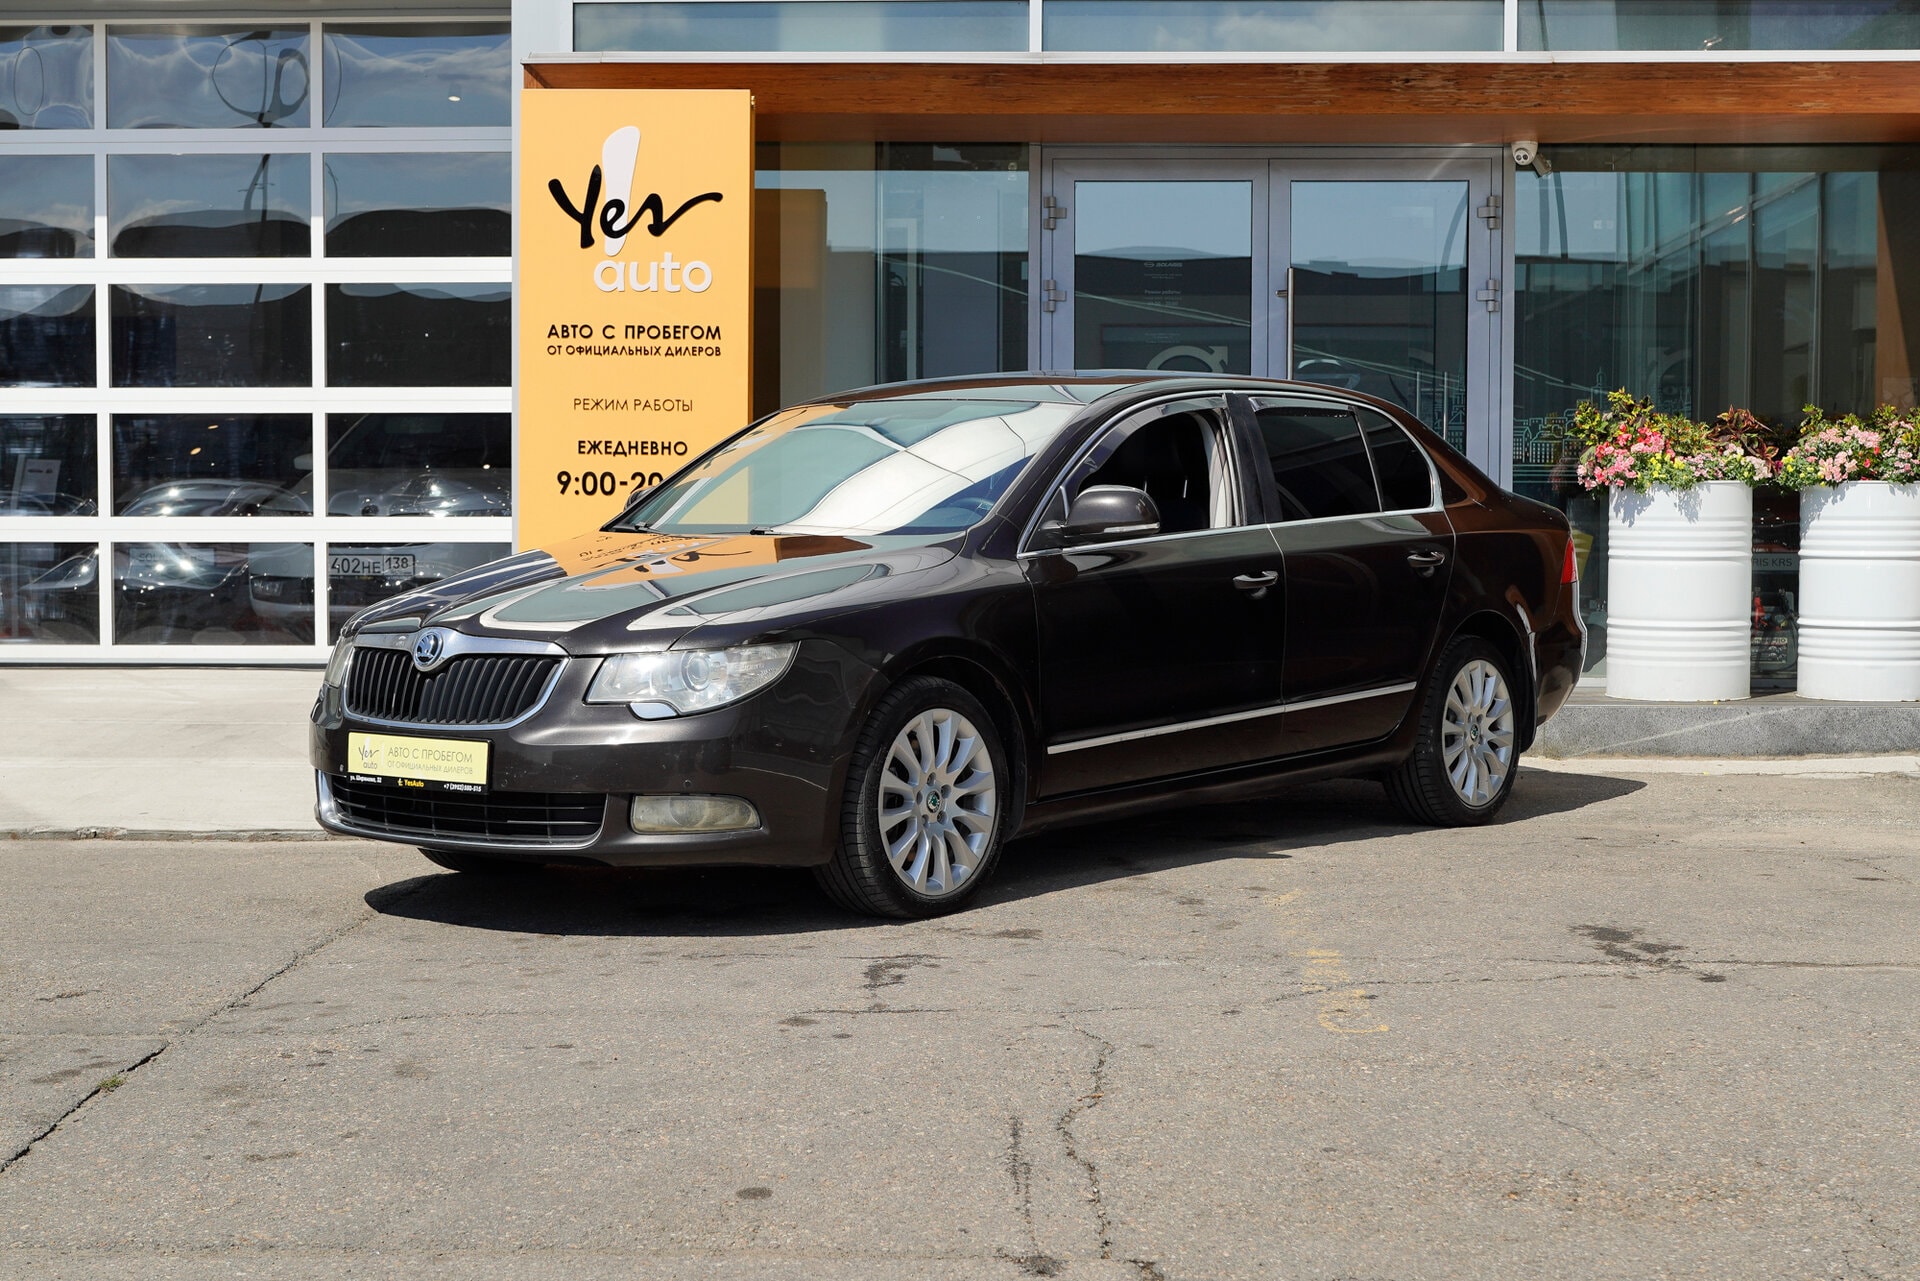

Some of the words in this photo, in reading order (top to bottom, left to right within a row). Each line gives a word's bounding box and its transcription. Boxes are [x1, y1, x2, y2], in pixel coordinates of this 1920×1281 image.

[548, 164, 723, 249] Yes
[593, 251, 713, 293] auto
[547, 324, 593, 339] АВТО
[602, 324, 616, 339] С
[625, 324, 721, 340] ПРОБЕГОМ
[547, 345, 562, 355] ОТ
[566, 345, 661, 357] ОФИЦИАЛЬНЫХ
[665, 346, 721, 357] ДИЛЕРОВ
[573, 398, 629, 411] РЕЖИМ
[634, 398, 693, 412] РАБОТЫ
[577, 440, 688, 457] ЕЖЕДНЕВНО
[385, 557, 409, 569] 138
[1771, 558, 1793, 567] KRS
[358, 744, 380, 761] Yes
[388, 746, 410, 759] АВТО
[412, 748, 420, 760] С
[422, 749, 473, 763] ПРОБЕГОМ
[363, 761, 378, 770] auto
[387, 760, 395, 768] ОТ
[395, 761, 442, 773] ОФИЦИАЛЬНЫХ
[443, 765, 473, 775] ДИЛЕРОВ
[404, 778, 424, 788] YesAuto
